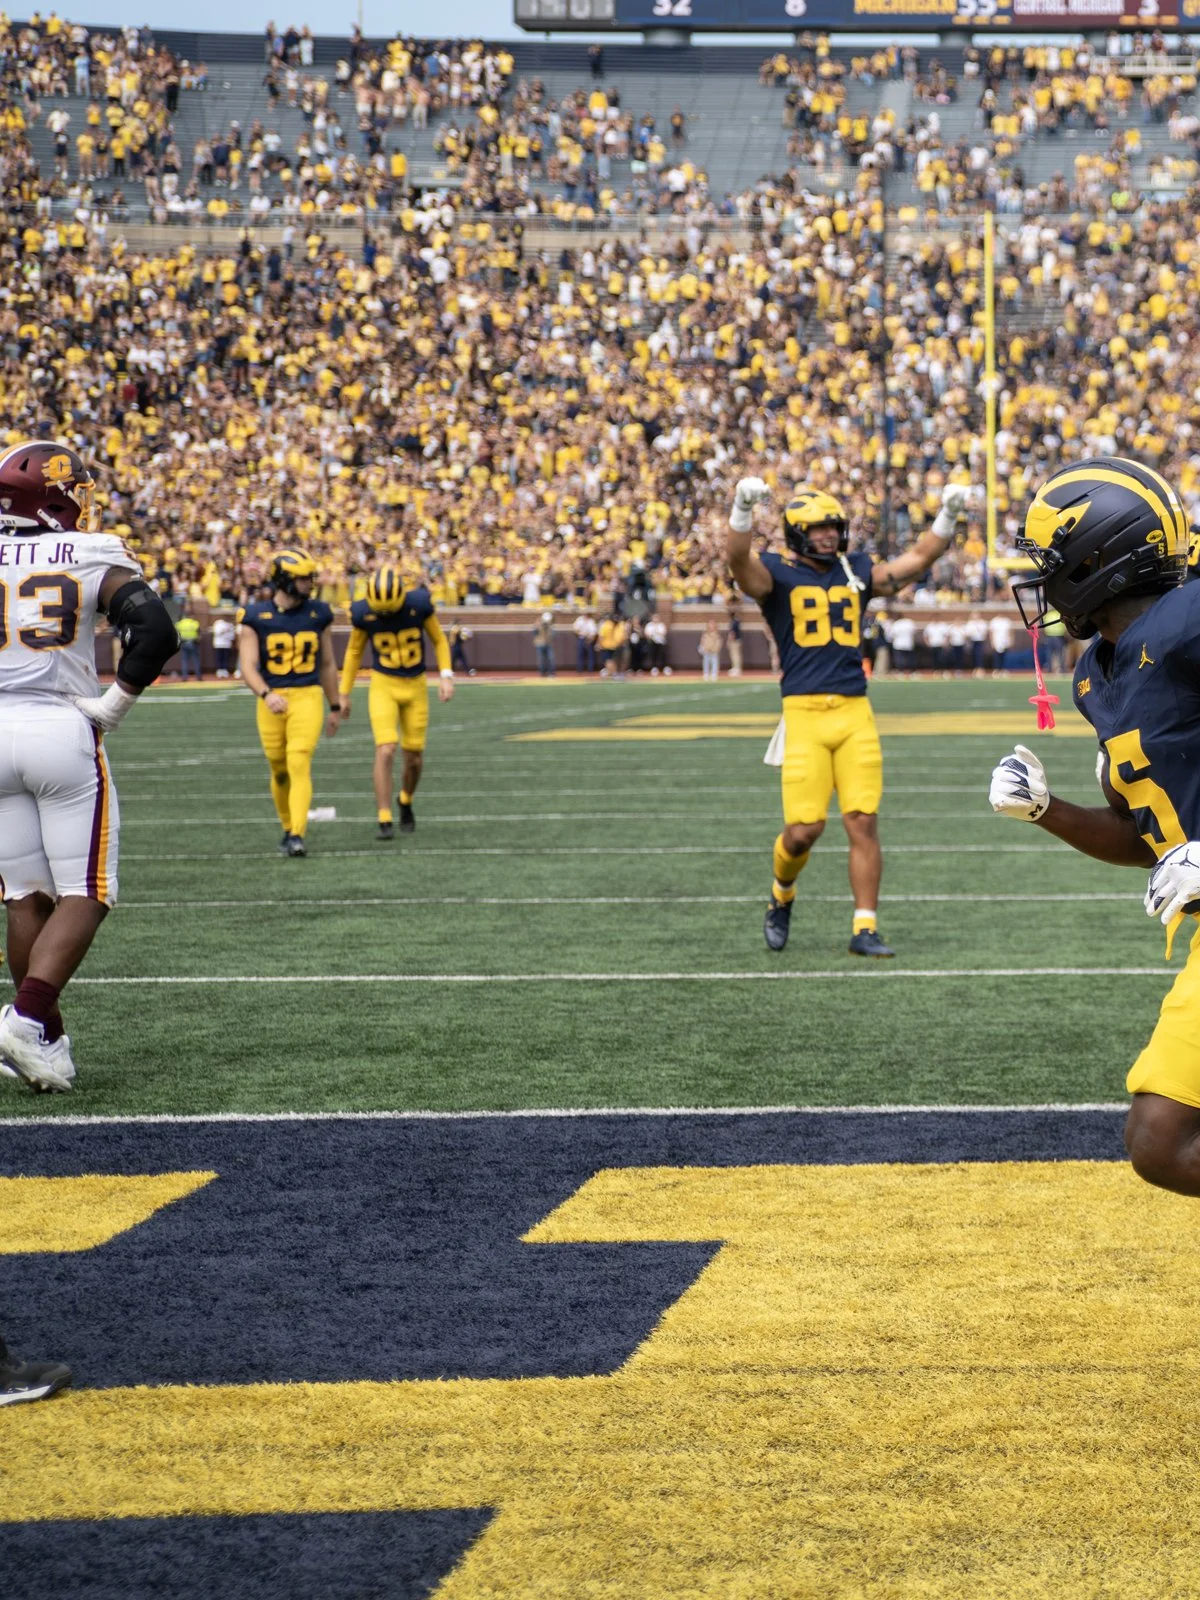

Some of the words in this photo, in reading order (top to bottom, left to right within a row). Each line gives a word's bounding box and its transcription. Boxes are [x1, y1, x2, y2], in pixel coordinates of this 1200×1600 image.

[48, 543, 79, 565] JR.
[0, 571, 83, 652] 3
[790, 585, 861, 648] 83
[1104, 729, 1188, 860] 5
